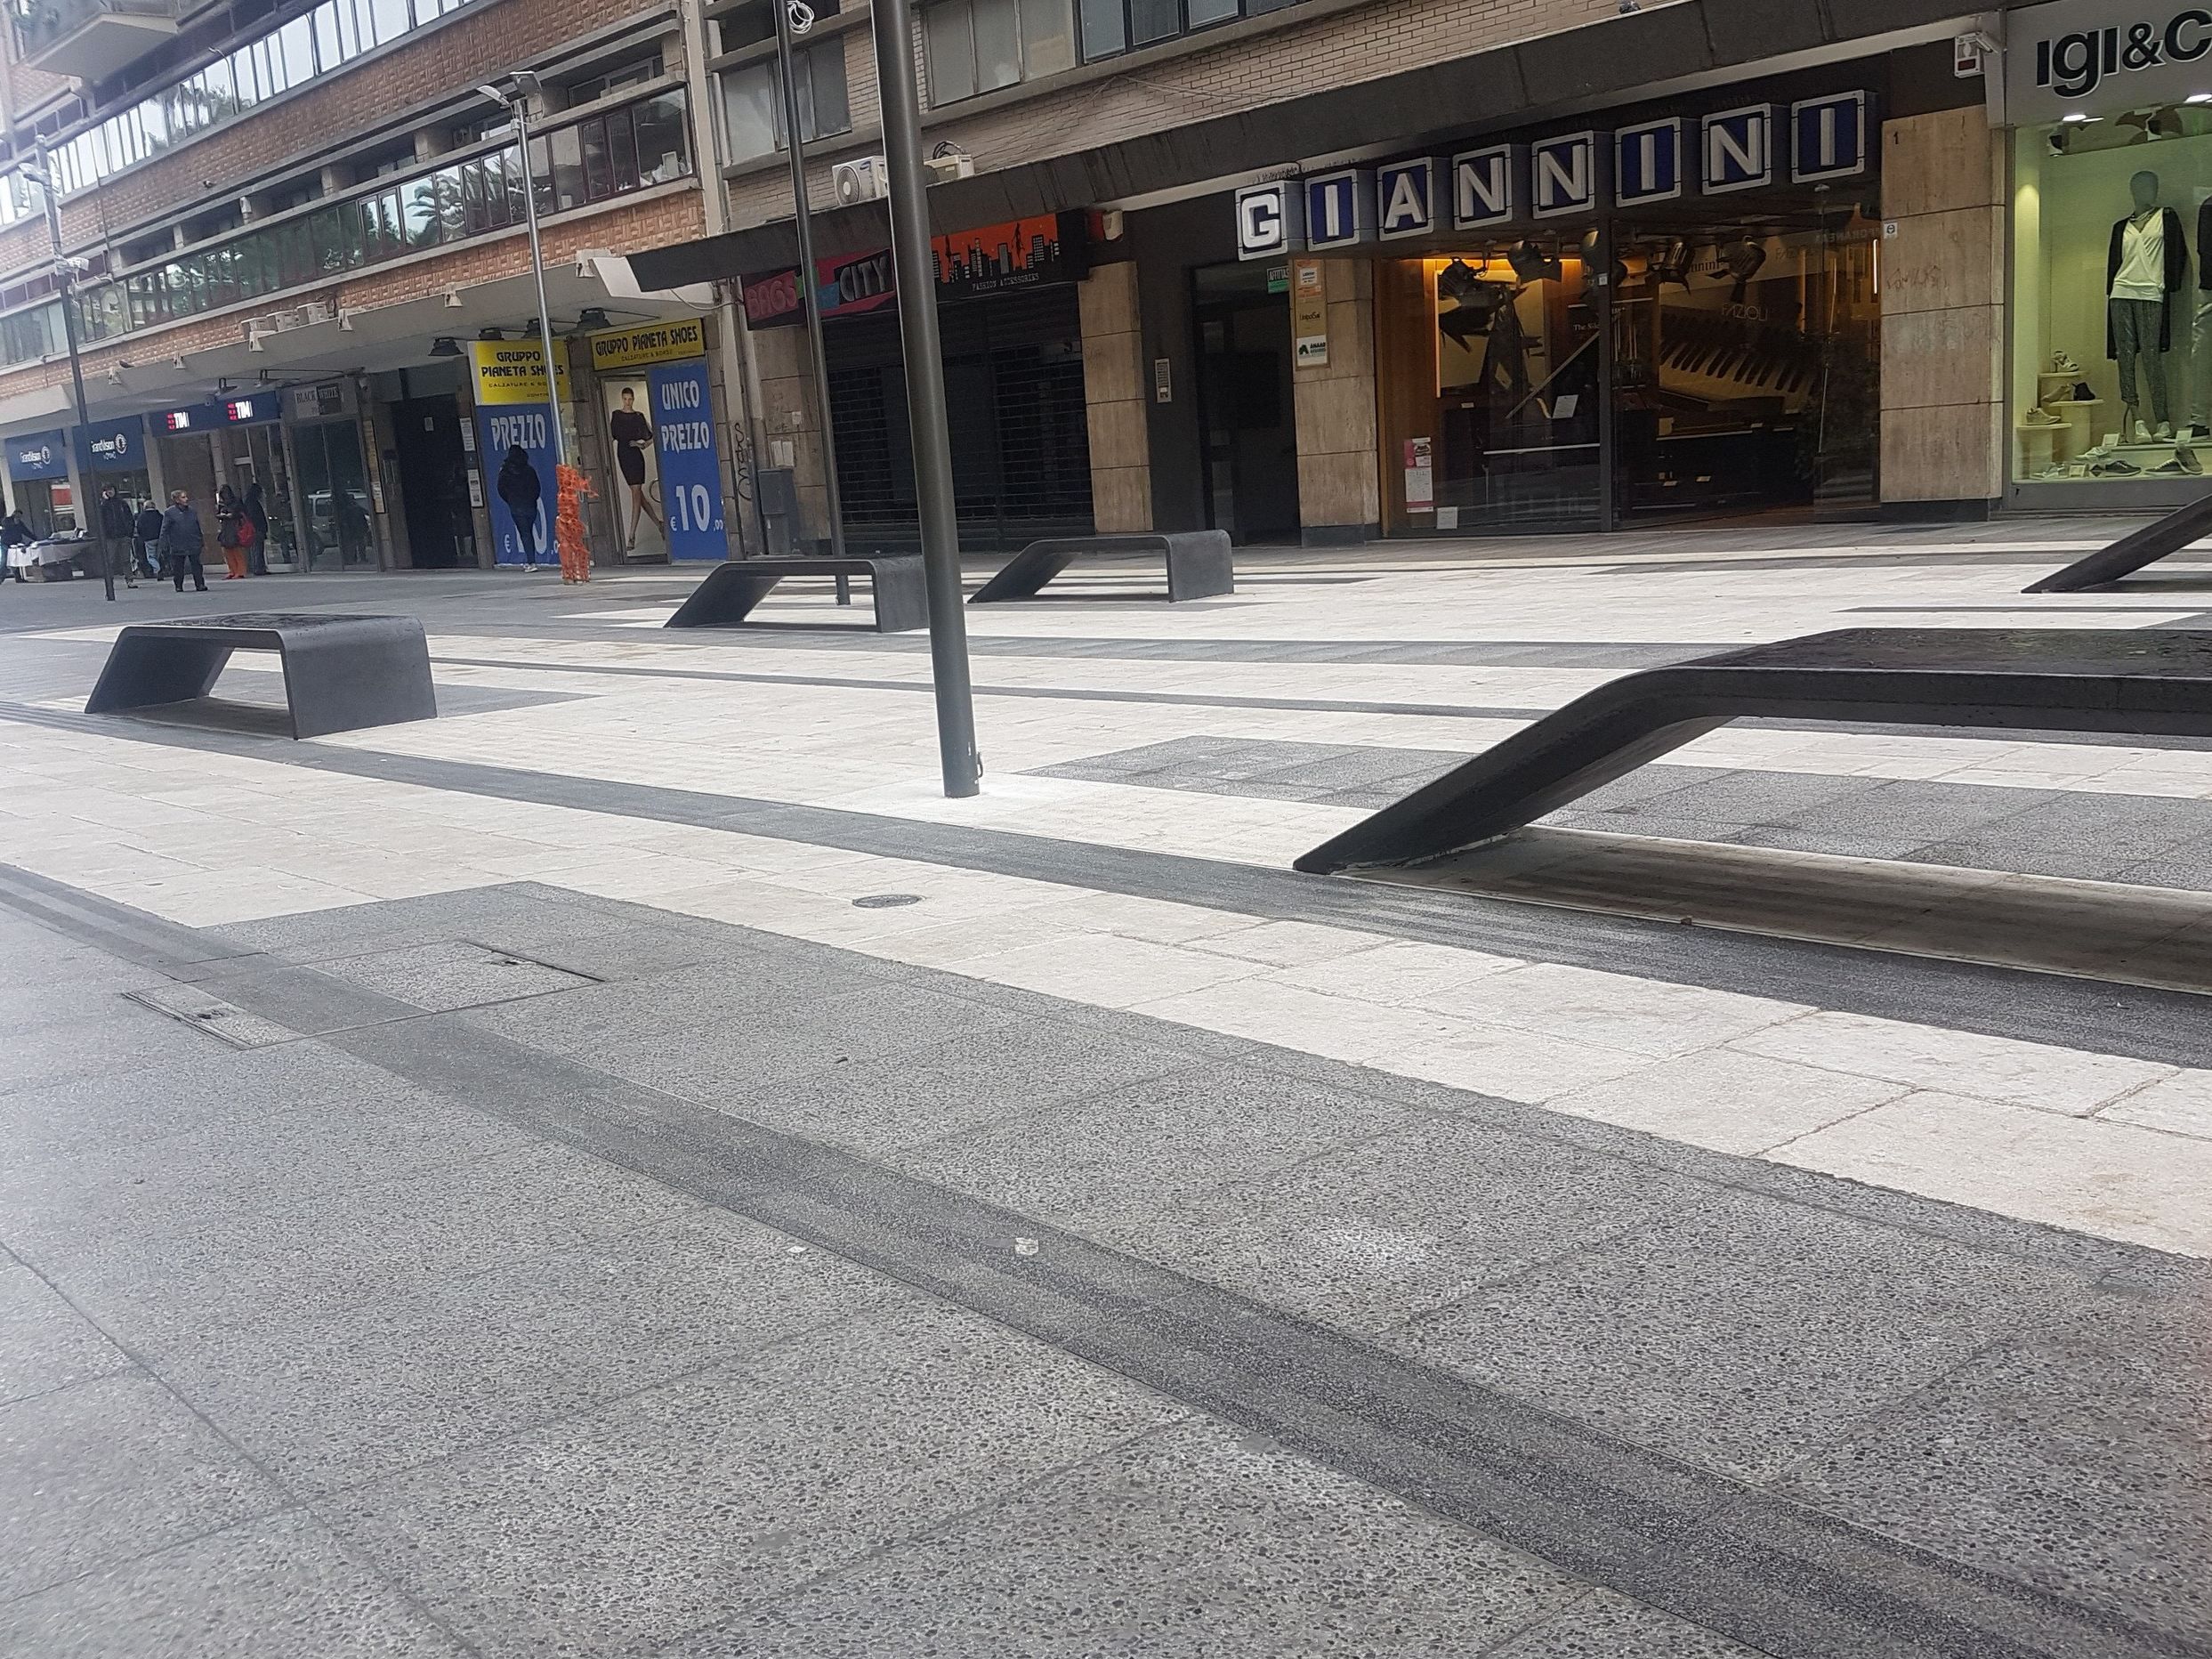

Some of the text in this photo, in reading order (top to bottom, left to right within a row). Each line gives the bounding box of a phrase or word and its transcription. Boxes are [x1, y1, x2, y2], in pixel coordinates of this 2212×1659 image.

[1240, 106, 1837, 250] GIANNINI
[746, 255, 889, 319] BAGS CITY
[596, 325, 698, 357] GRUPPO PIANETA SHOES
[480, 364, 564, 377] PIANETA SHS
[496, 351, 541, 363] GRUPPO
[235, 401, 253, 419] TIM
[661, 379, 699, 410] UNICO
[174, 411, 190, 429] TIM
[490, 413, 546, 451] PREZZO
[660, 421, 710, 454] PREZZO
